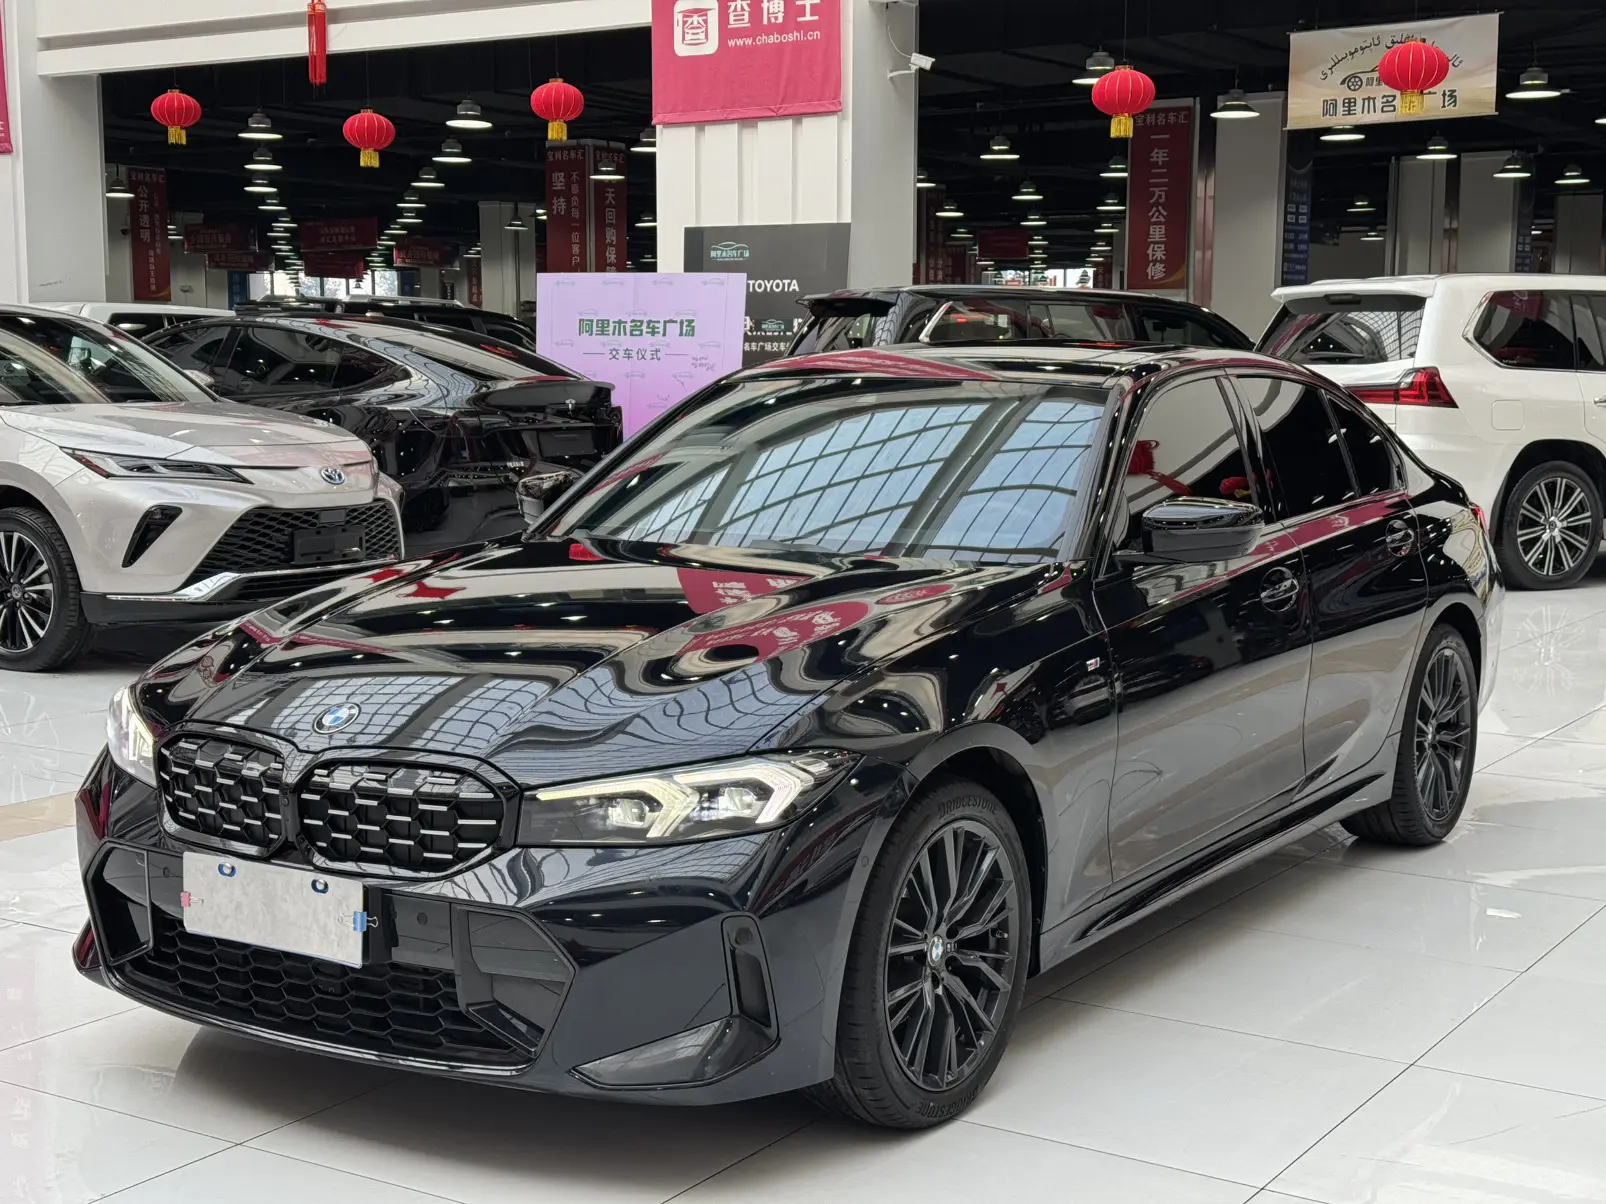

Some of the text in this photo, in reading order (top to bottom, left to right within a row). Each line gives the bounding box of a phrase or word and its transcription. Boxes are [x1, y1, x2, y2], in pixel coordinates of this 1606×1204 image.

[727, 30, 821, 48] www.chaboshi.cn
[551, 172, 567, 216] 坚持
[137, 185, 151, 243] 公开透明
[1146, 134, 1170, 281] 一年二万公里保修
[747, 279, 800, 293] TOYOTA
[578, 318, 695, 337] 阿里木名车广场
[608, 347, 661, 361] 交车仪式
[744, 342, 789, 352] 名车广场交车
